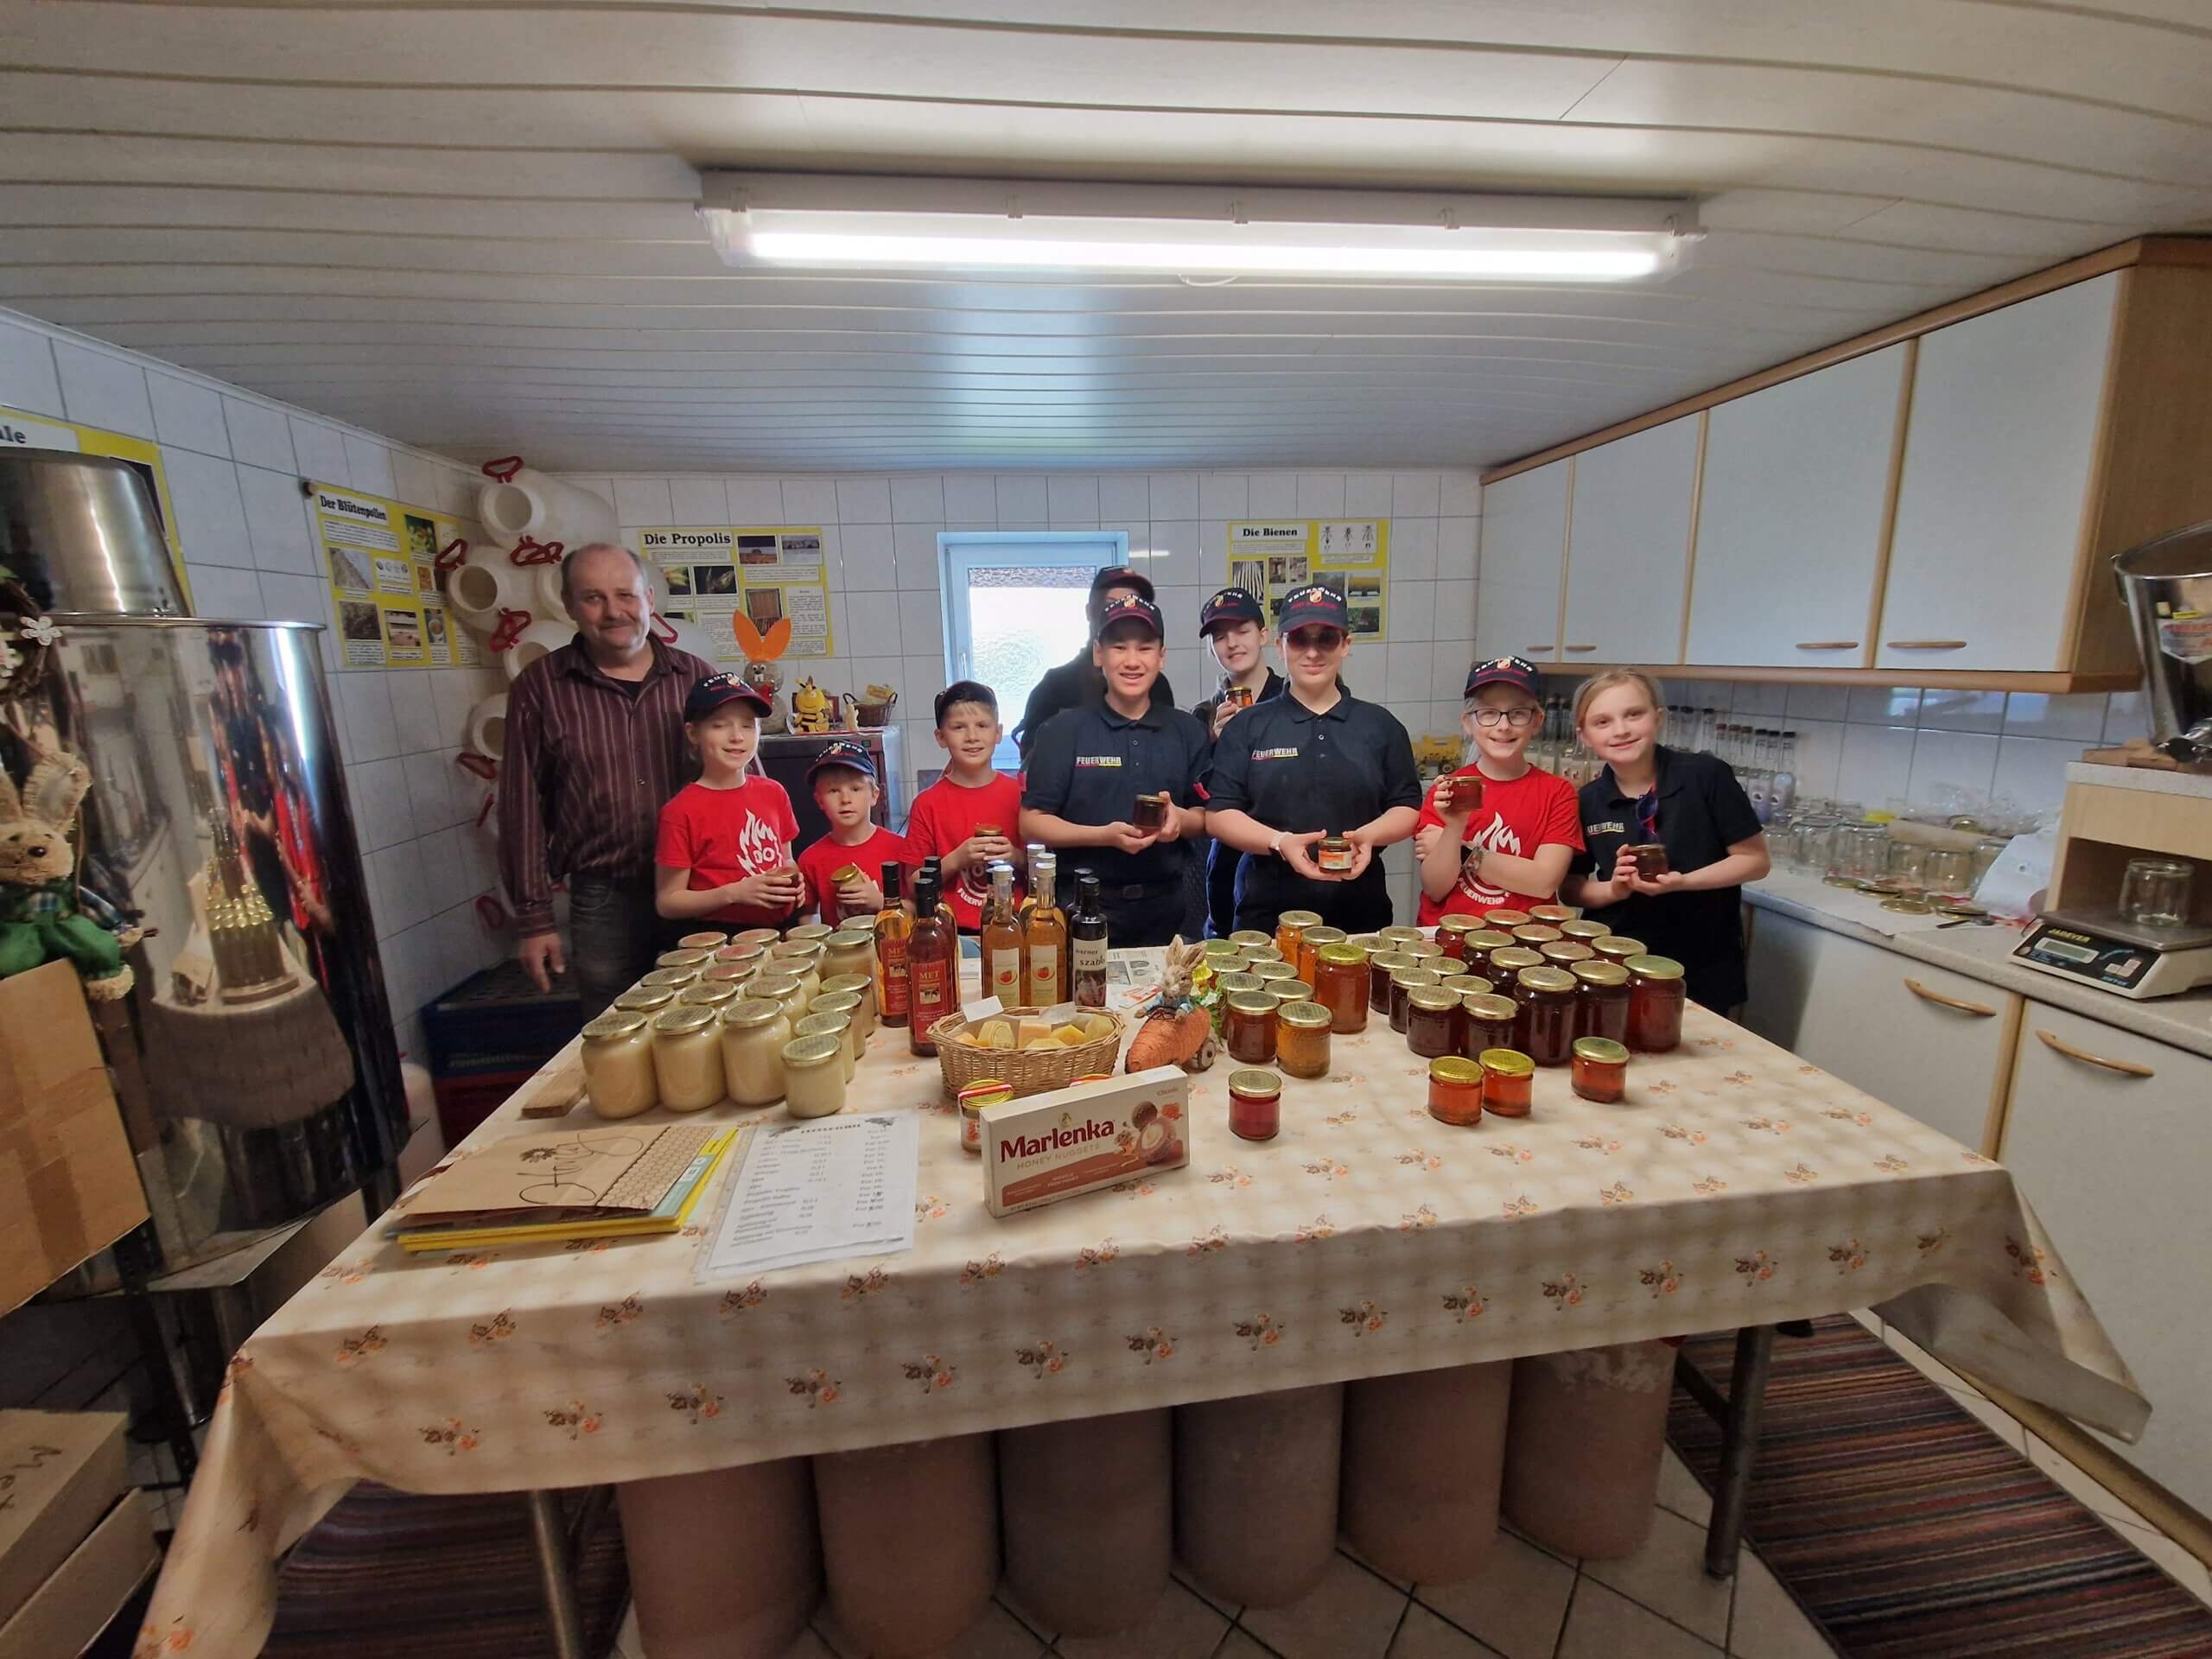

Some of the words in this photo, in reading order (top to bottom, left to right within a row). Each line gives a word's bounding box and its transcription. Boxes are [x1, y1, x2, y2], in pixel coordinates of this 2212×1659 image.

[319, 495, 335, 510] Der
[337, 499, 388, 520] Blütenpollen
[1243, 528, 1260, 537] Die
[1263, 528, 1298, 537] Bienen
[644, 533, 667, 545] Die
[671, 532, 732, 547] Propolis
[1251, 747, 1298, 759] FEUERWEHR
[1076, 756, 1122, 766] FEUERWEHR
[1586, 821, 1624, 833] UERWEHR
[918, 970, 940, 981] MET
[1000, 1119, 1116, 1163] Marlenka
[1016, 1154, 1052, 1171] HONEY
[1054, 1142, 1101, 1161] NUGGETS
